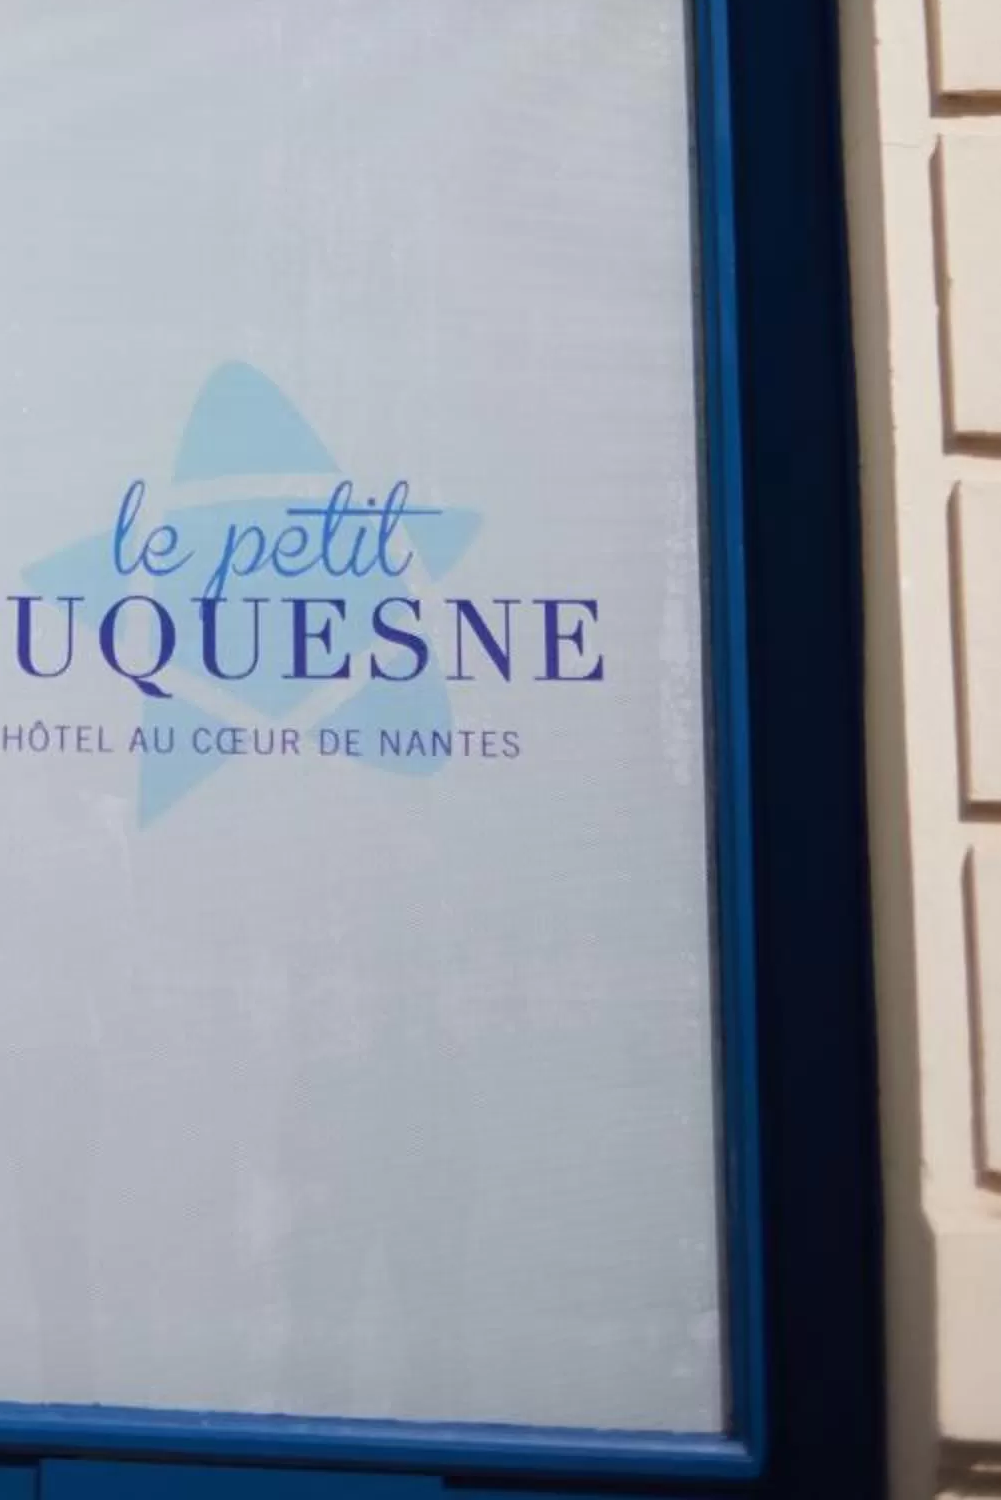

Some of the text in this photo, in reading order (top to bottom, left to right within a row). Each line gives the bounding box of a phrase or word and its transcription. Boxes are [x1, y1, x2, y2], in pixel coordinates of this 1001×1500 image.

[112, 478, 443, 612] le petit
[1, 719, 522, 760] HÔTEL AU CŒUR DE NANTES
